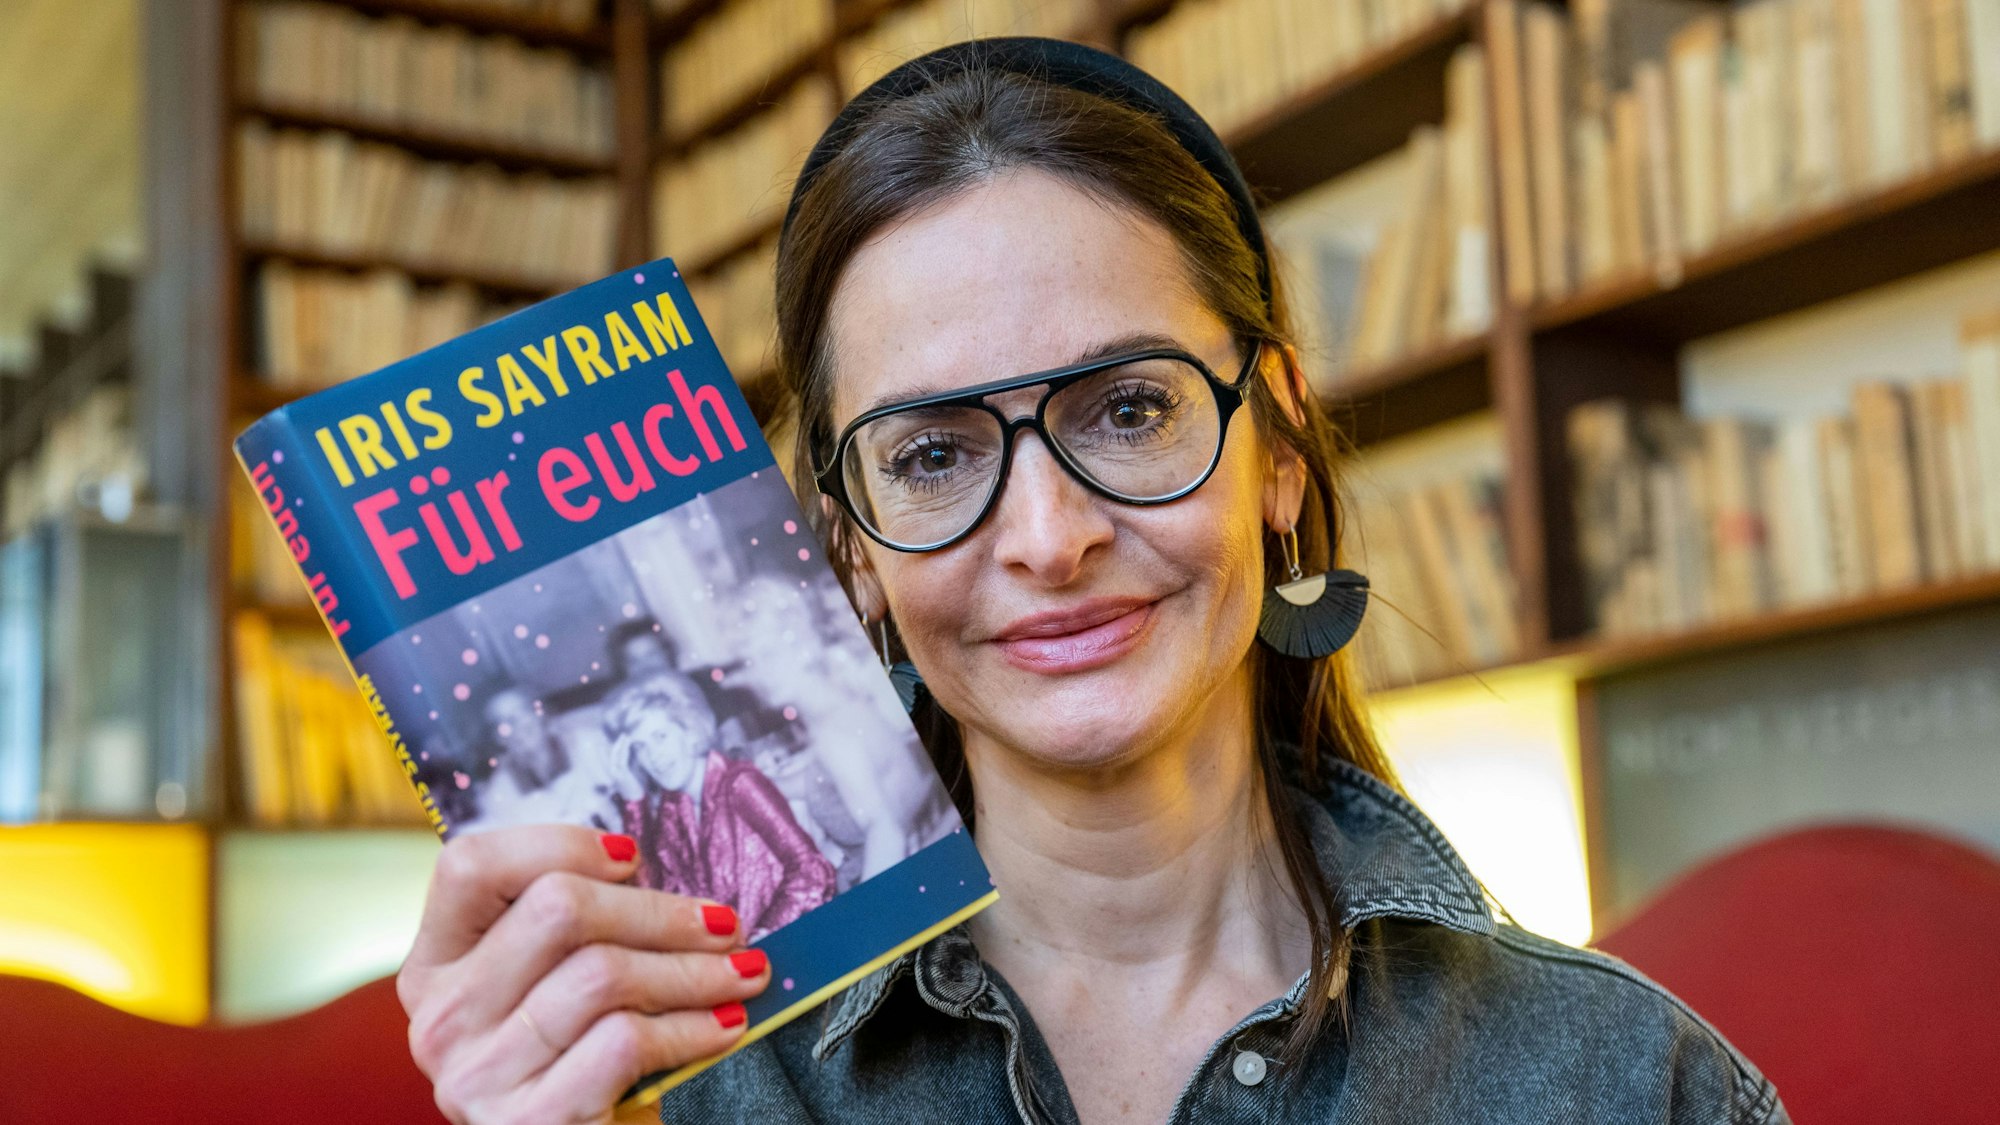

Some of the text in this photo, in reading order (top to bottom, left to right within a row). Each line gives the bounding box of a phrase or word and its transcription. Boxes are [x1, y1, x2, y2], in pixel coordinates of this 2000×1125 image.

[315, 292, 693, 487] IRIS SAYRAM
[353, 369, 748, 600] Für euch
